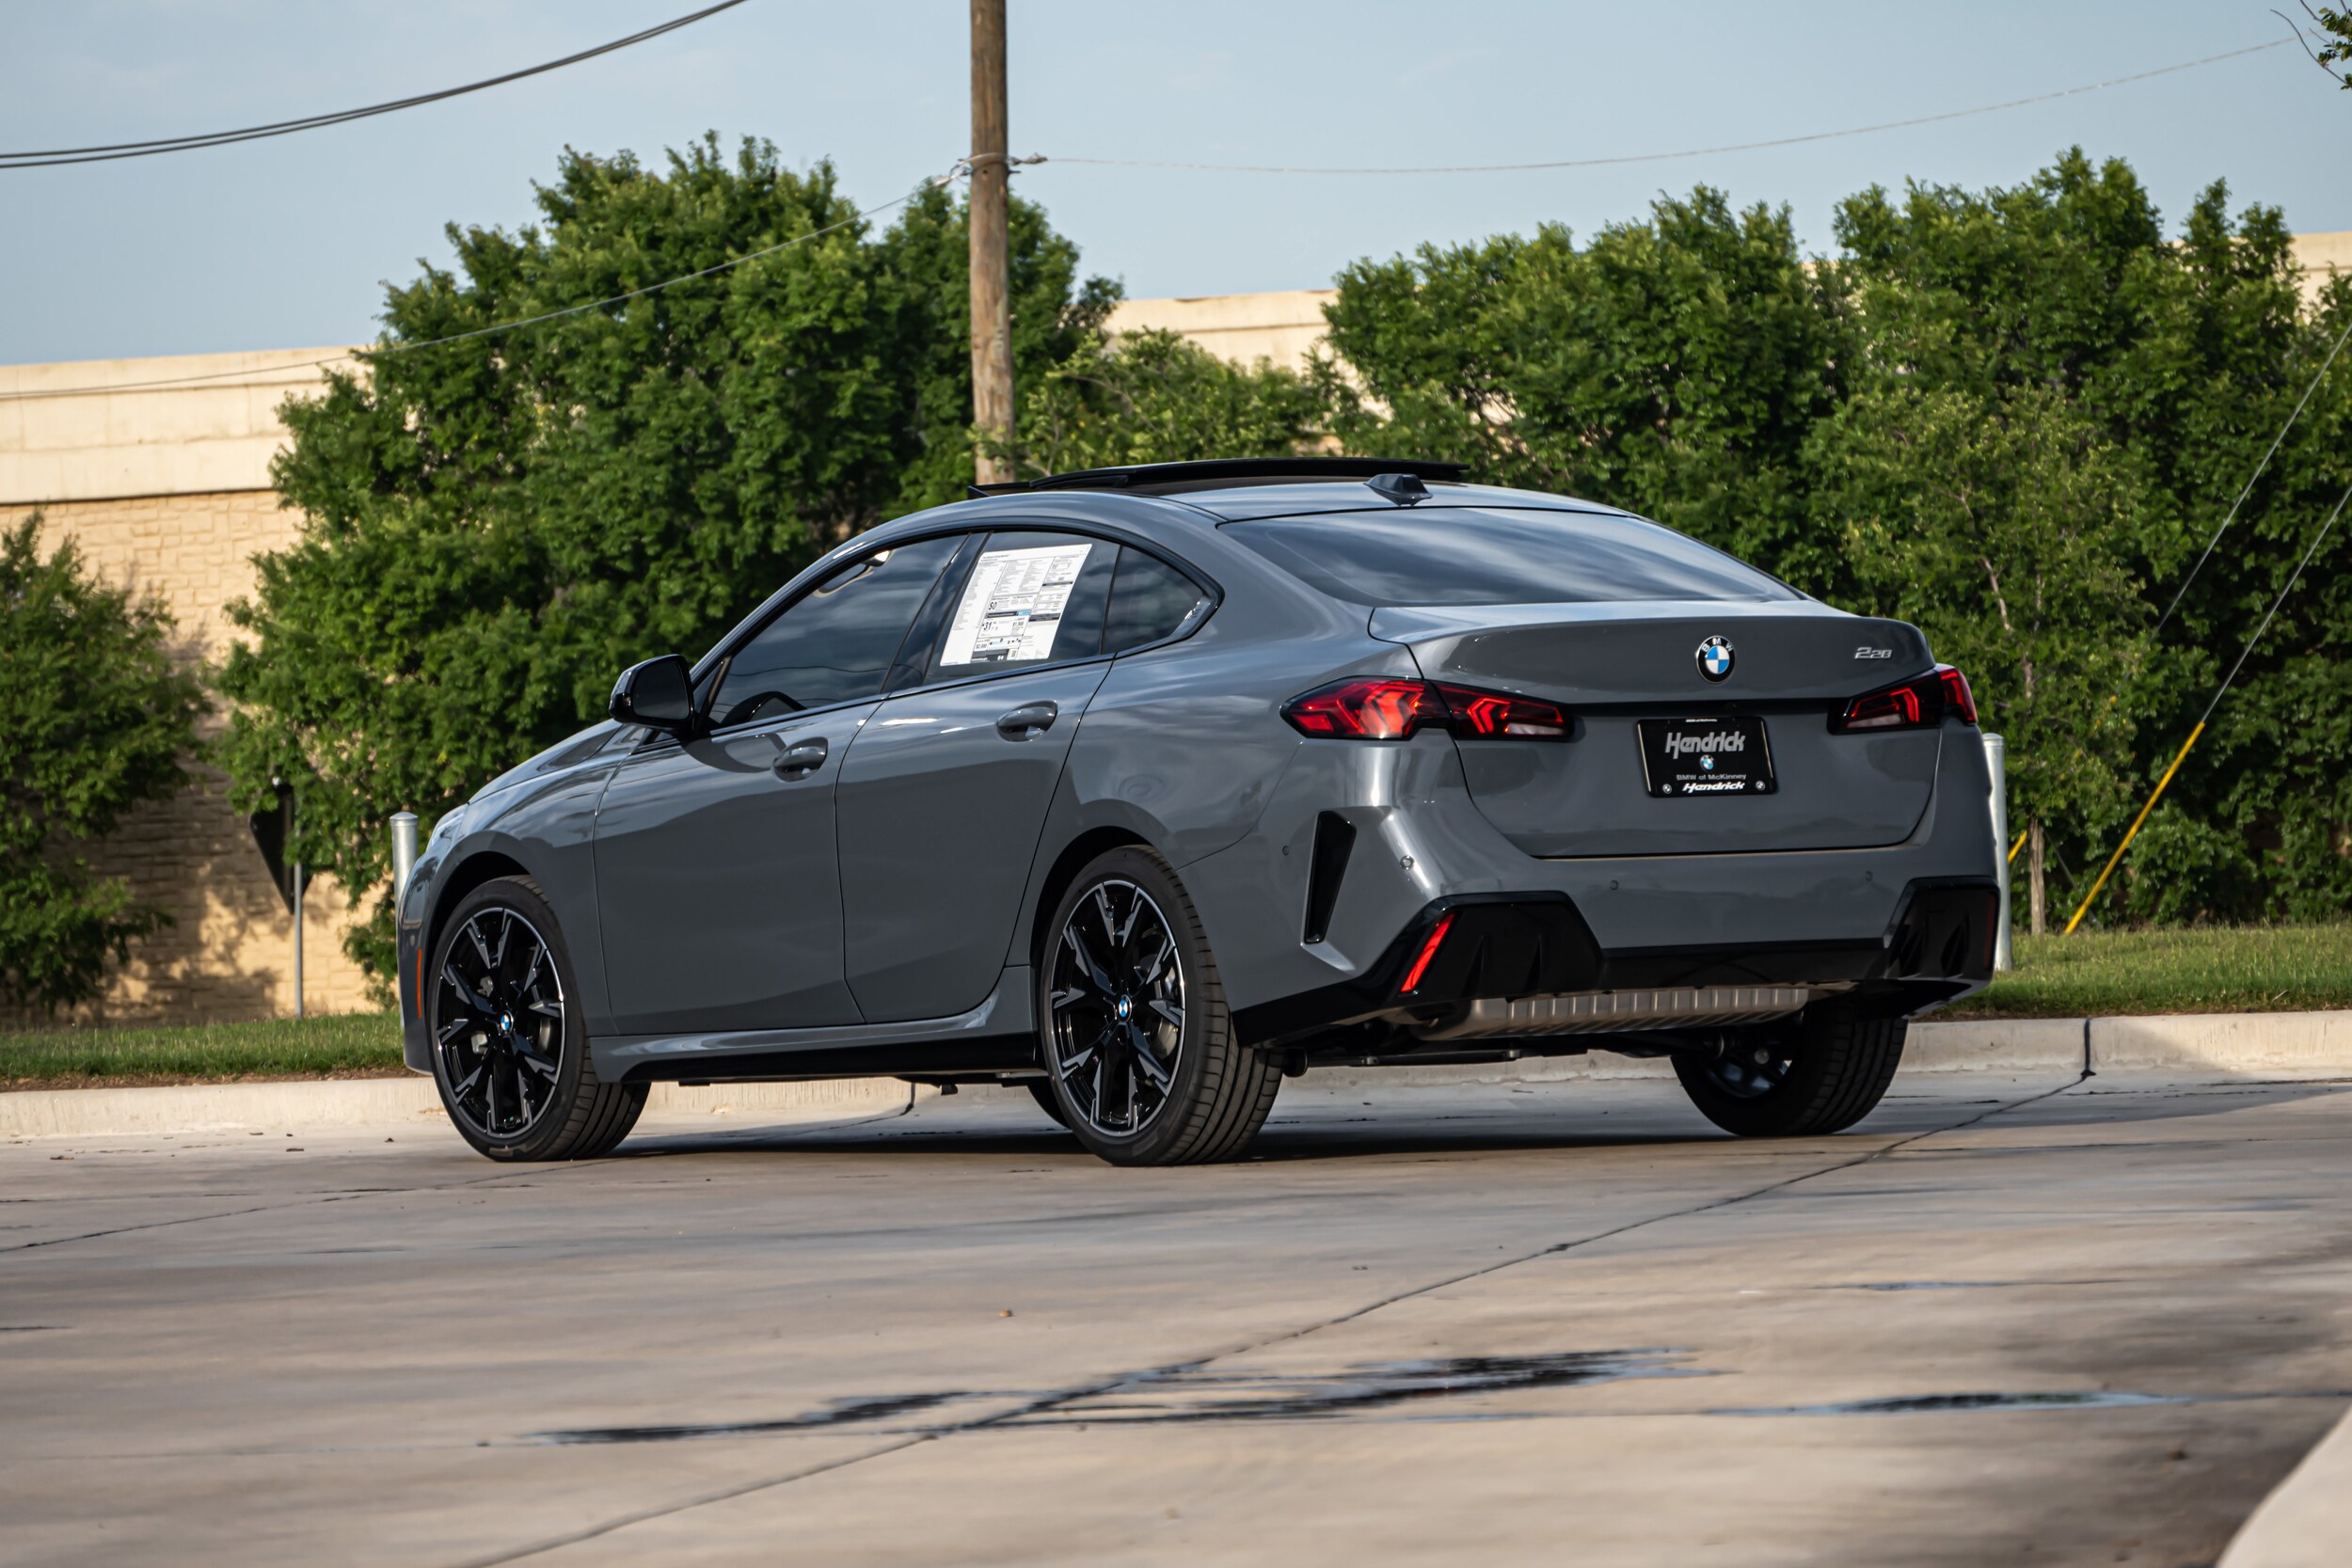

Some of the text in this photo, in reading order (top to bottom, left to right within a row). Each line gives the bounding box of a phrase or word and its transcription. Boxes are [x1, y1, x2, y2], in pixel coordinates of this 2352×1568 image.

[1701, 637, 1733, 653] BMW
[1854, 646, 1893, 659] 228
[1665, 731, 1745, 759] Hendrick
[1682, 782, 1745, 793] Hendrick
